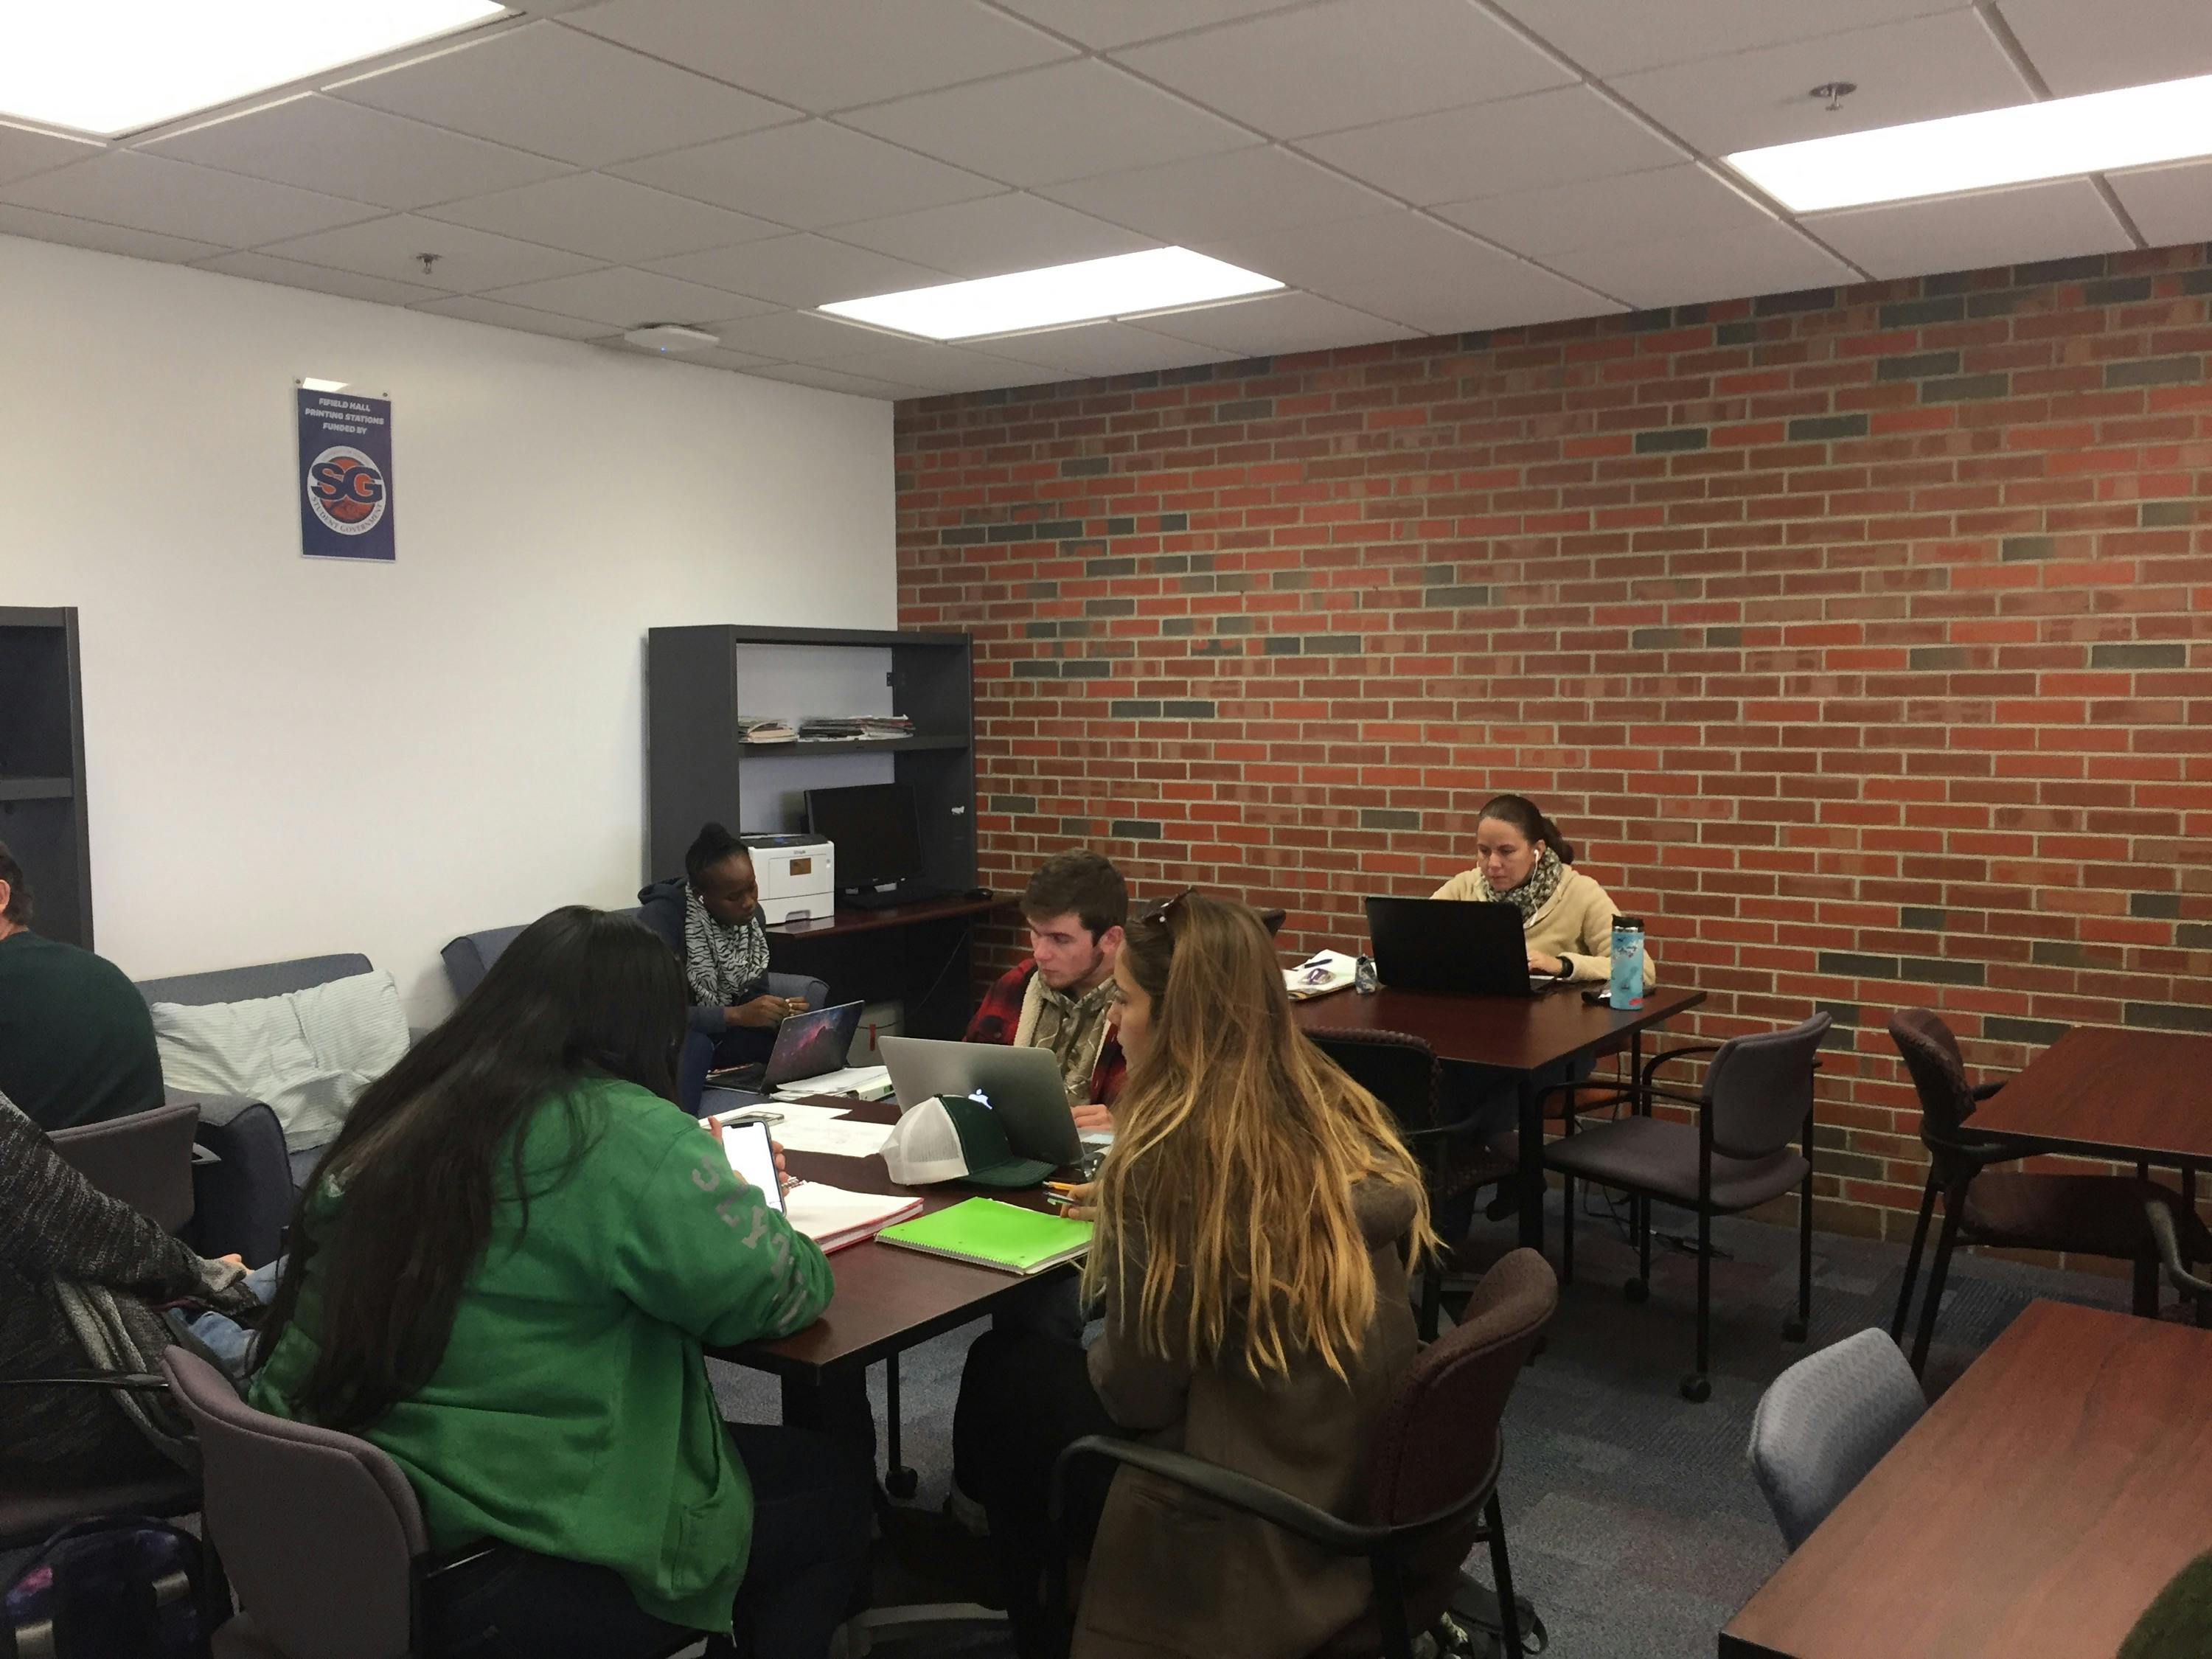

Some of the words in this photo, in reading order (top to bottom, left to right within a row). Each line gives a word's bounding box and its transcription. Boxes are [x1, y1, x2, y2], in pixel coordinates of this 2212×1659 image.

[319, 397, 349, 408] FIFIELD
[349, 401, 370, 412] HALL
[305, 408, 344, 420] PRINTING
[344, 414, 385, 425] STATIONS
[322, 422, 355, 433] FUNDED
[356, 427, 367, 435] BY
[310, 462, 382, 503] SG
[311, 496, 338, 529] STUDENT
[340, 504, 382, 532] GOVERNMENT
